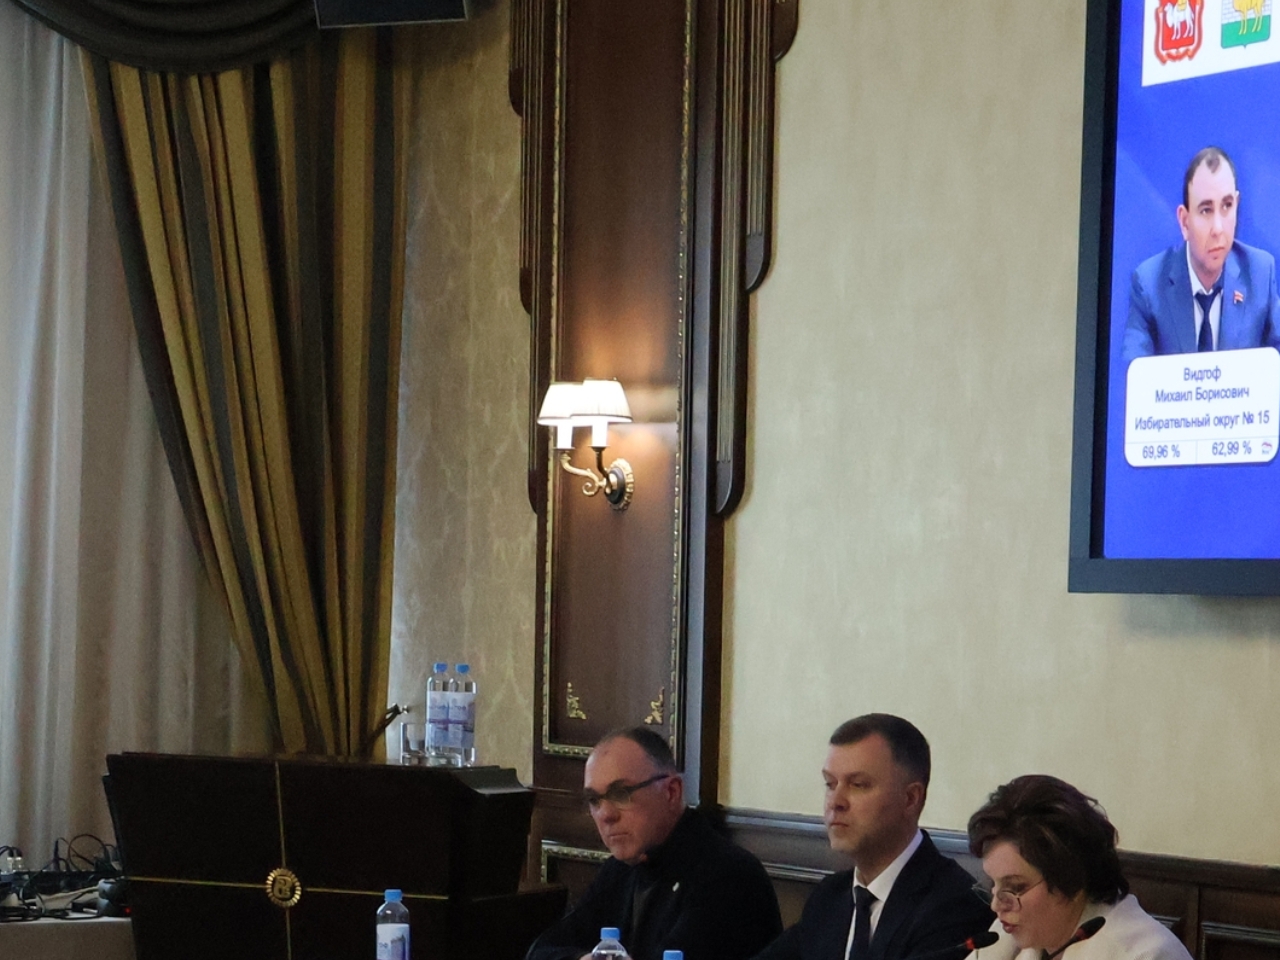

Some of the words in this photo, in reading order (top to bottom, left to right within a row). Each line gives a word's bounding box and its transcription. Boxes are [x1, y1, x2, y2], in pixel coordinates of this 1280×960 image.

[1184, 365, 1221, 382] Видгоф
[1155, 390, 1192, 403] Михаил
[1196, 387, 1249, 402] Борисович
[1135, 413, 1210, 432] Избирательный
[1213, 414, 1240, 429] округ
[1242, 411, 1254, 425] №
[1258, 410, 1269, 423] 15
[1142, 446, 1168, 460] 69,96
[1172, 444, 1180, 458] %
[1212, 442, 1239, 457] 62,99
[1243, 440, 1252, 455] %
